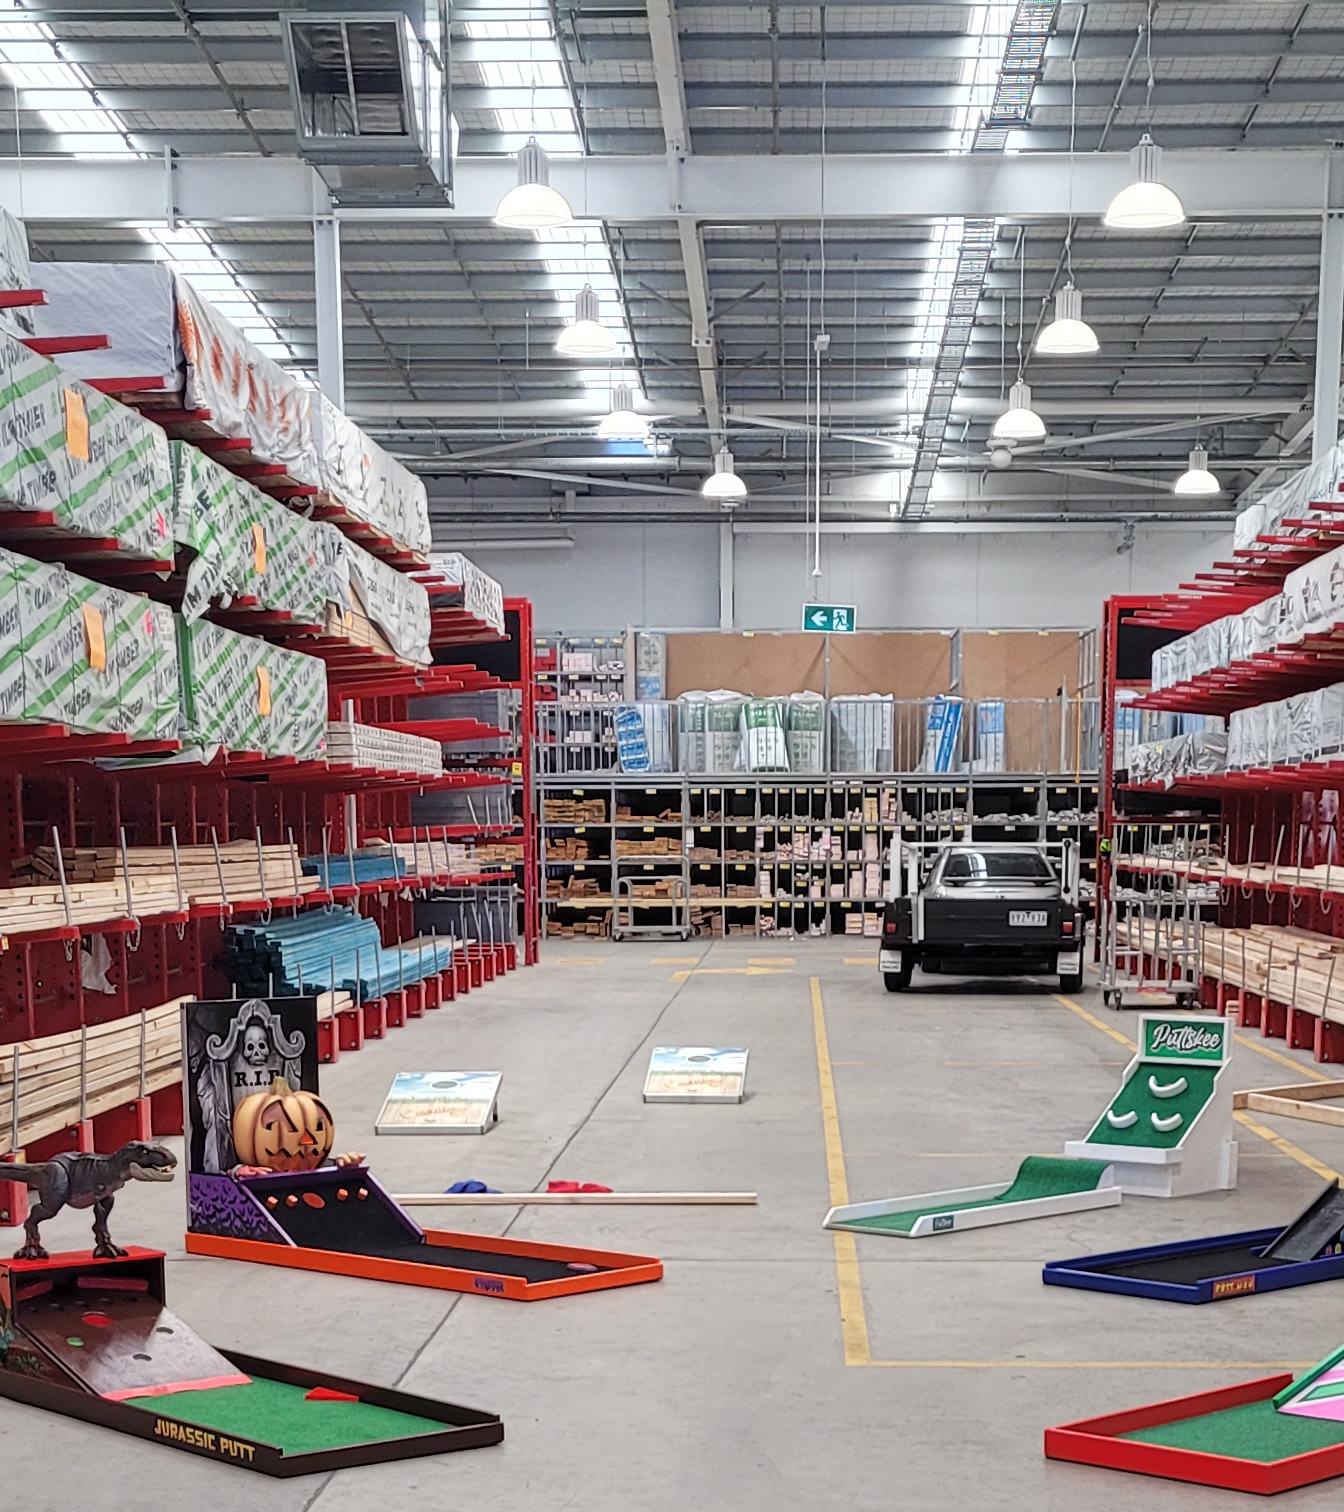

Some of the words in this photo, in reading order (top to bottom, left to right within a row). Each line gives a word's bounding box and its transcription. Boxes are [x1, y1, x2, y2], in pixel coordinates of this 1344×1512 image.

[1150, 1022, 1223, 1051] Puttskee
[153, 1418, 215, 1451] JURASSIC
[219, 1437, 256, 1462] PUTT
